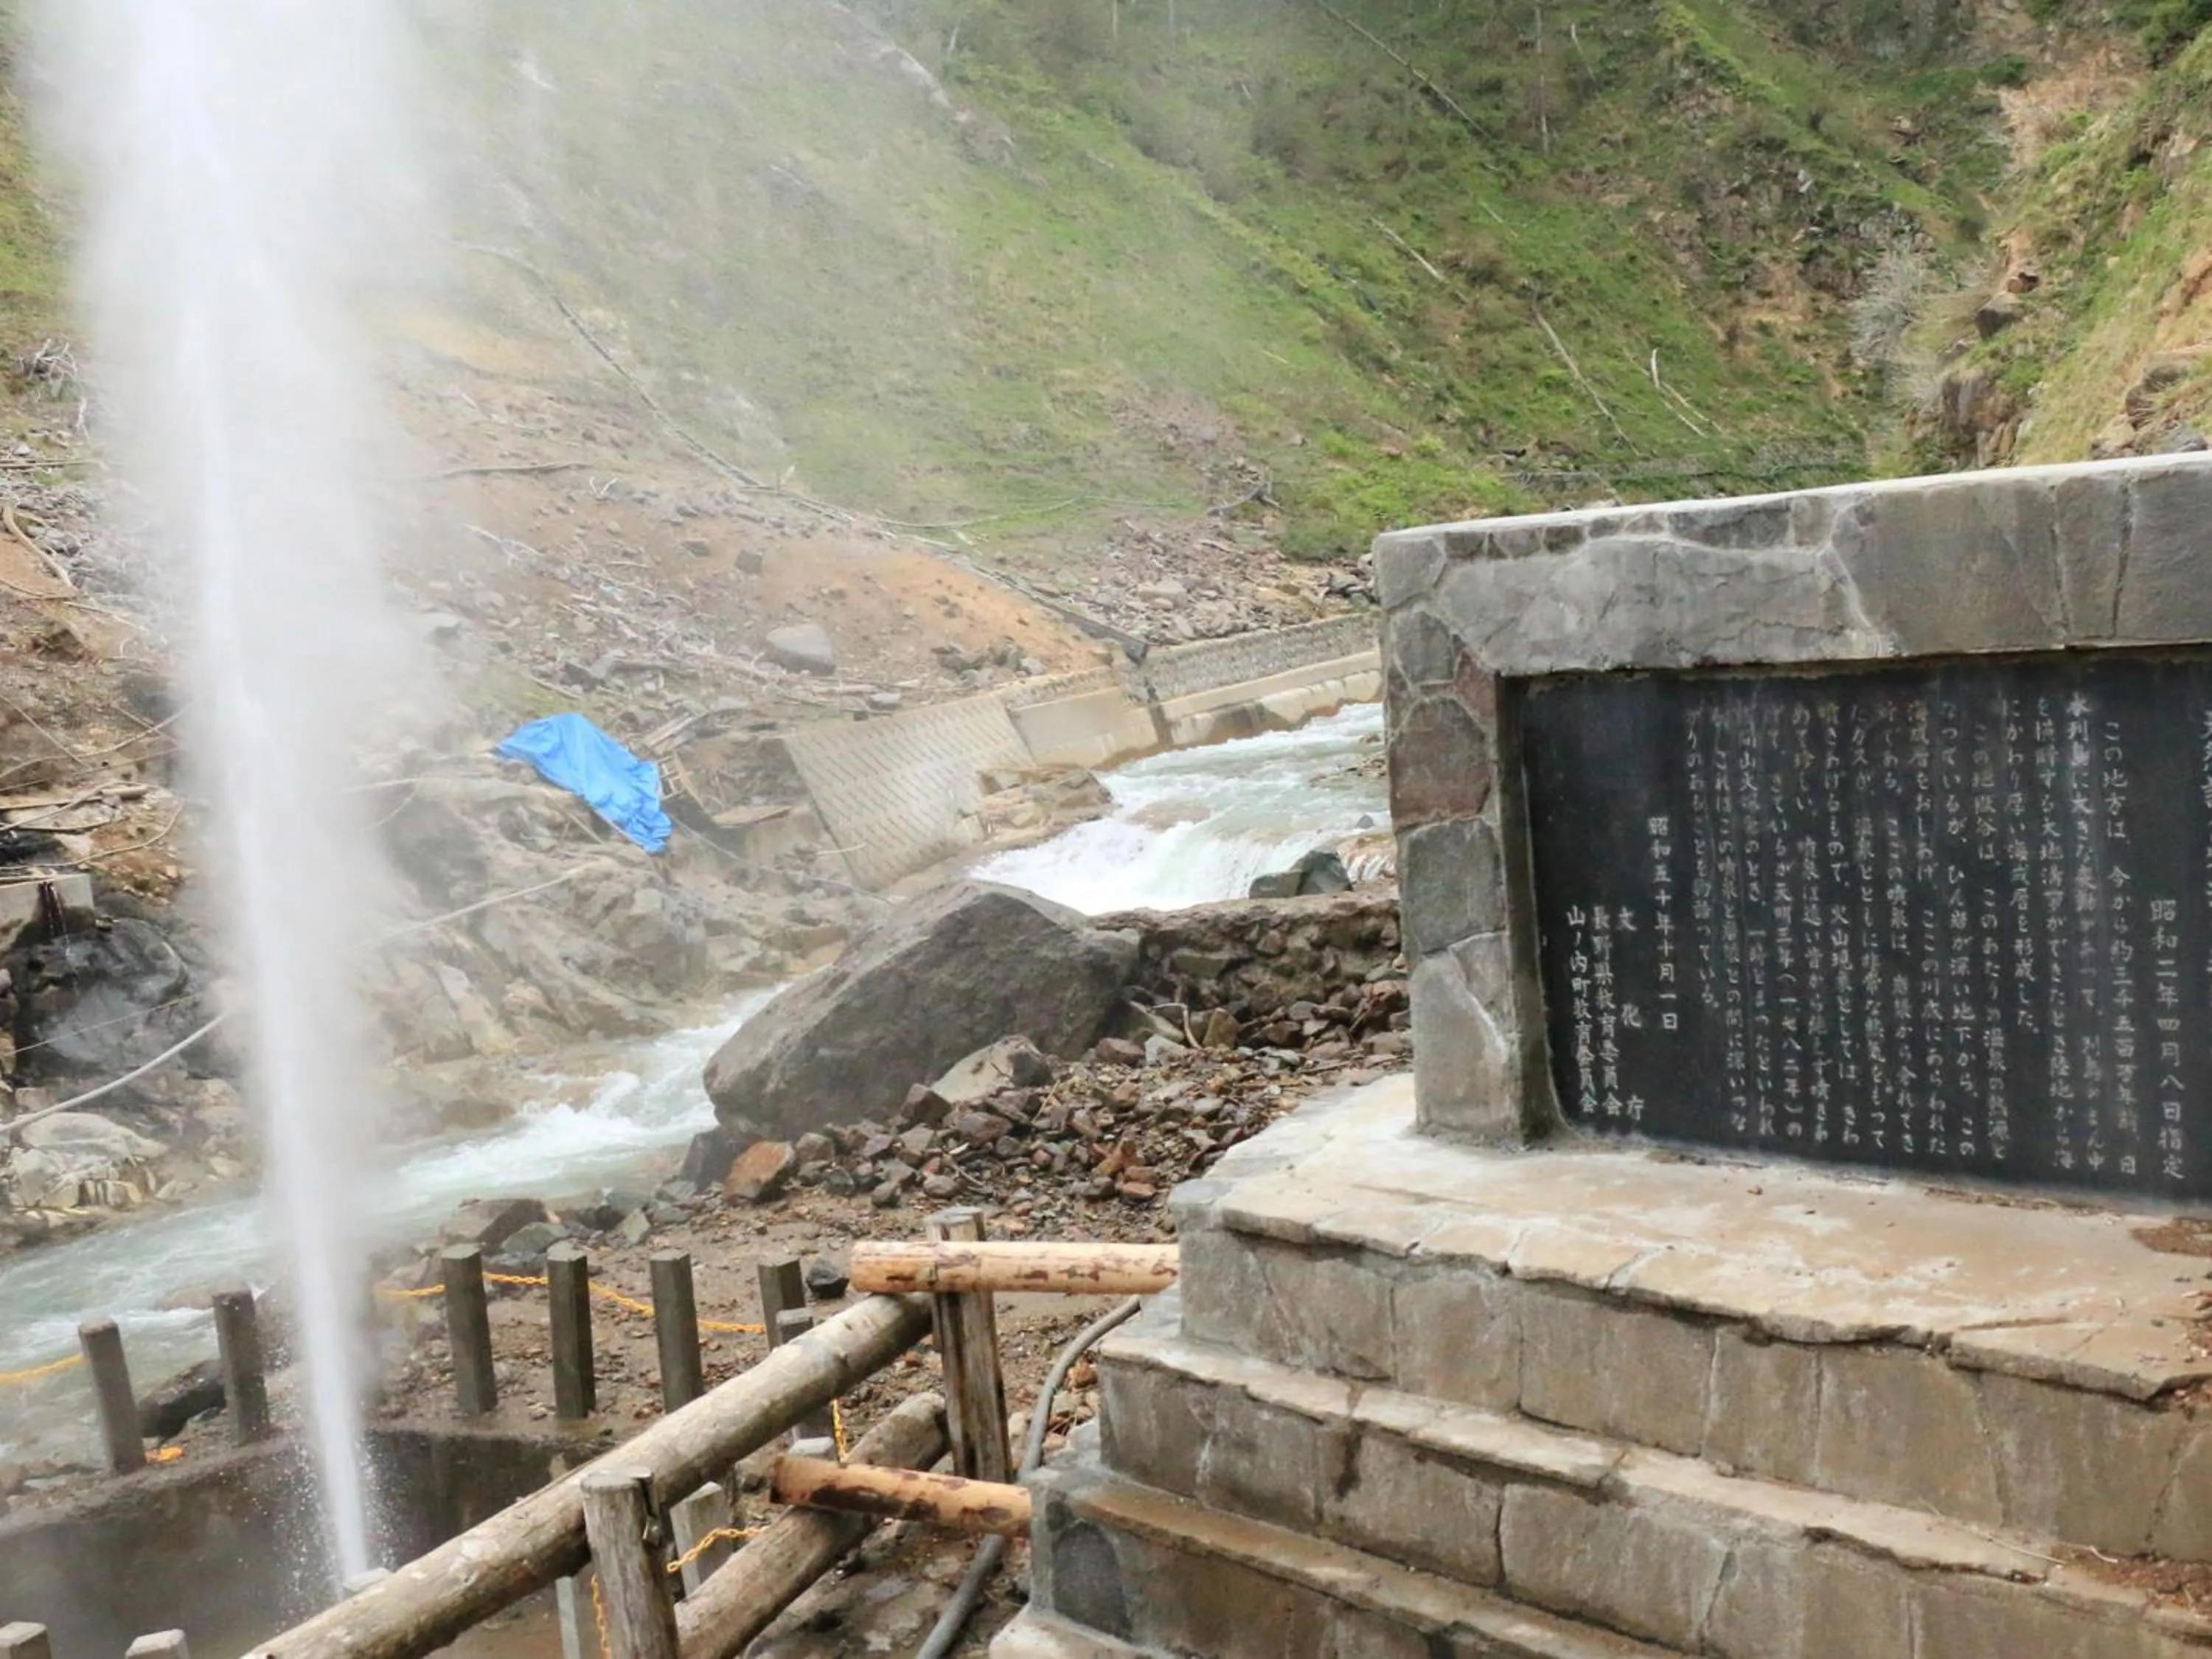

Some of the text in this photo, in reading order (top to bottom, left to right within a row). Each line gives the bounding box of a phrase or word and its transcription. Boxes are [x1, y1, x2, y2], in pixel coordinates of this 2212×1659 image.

[1568, 904, 1596, 1112] 山ノ内町教育委員会
[1593, 906, 1623, 1116] 長野県教育委員会
[1618, 908, 1644, 1120] 文化庁
[1648, 816, 1678, 1031] 昭和五十年十月一日
[2150, 900, 2184, 1178] 昭和二年四月八日指定
